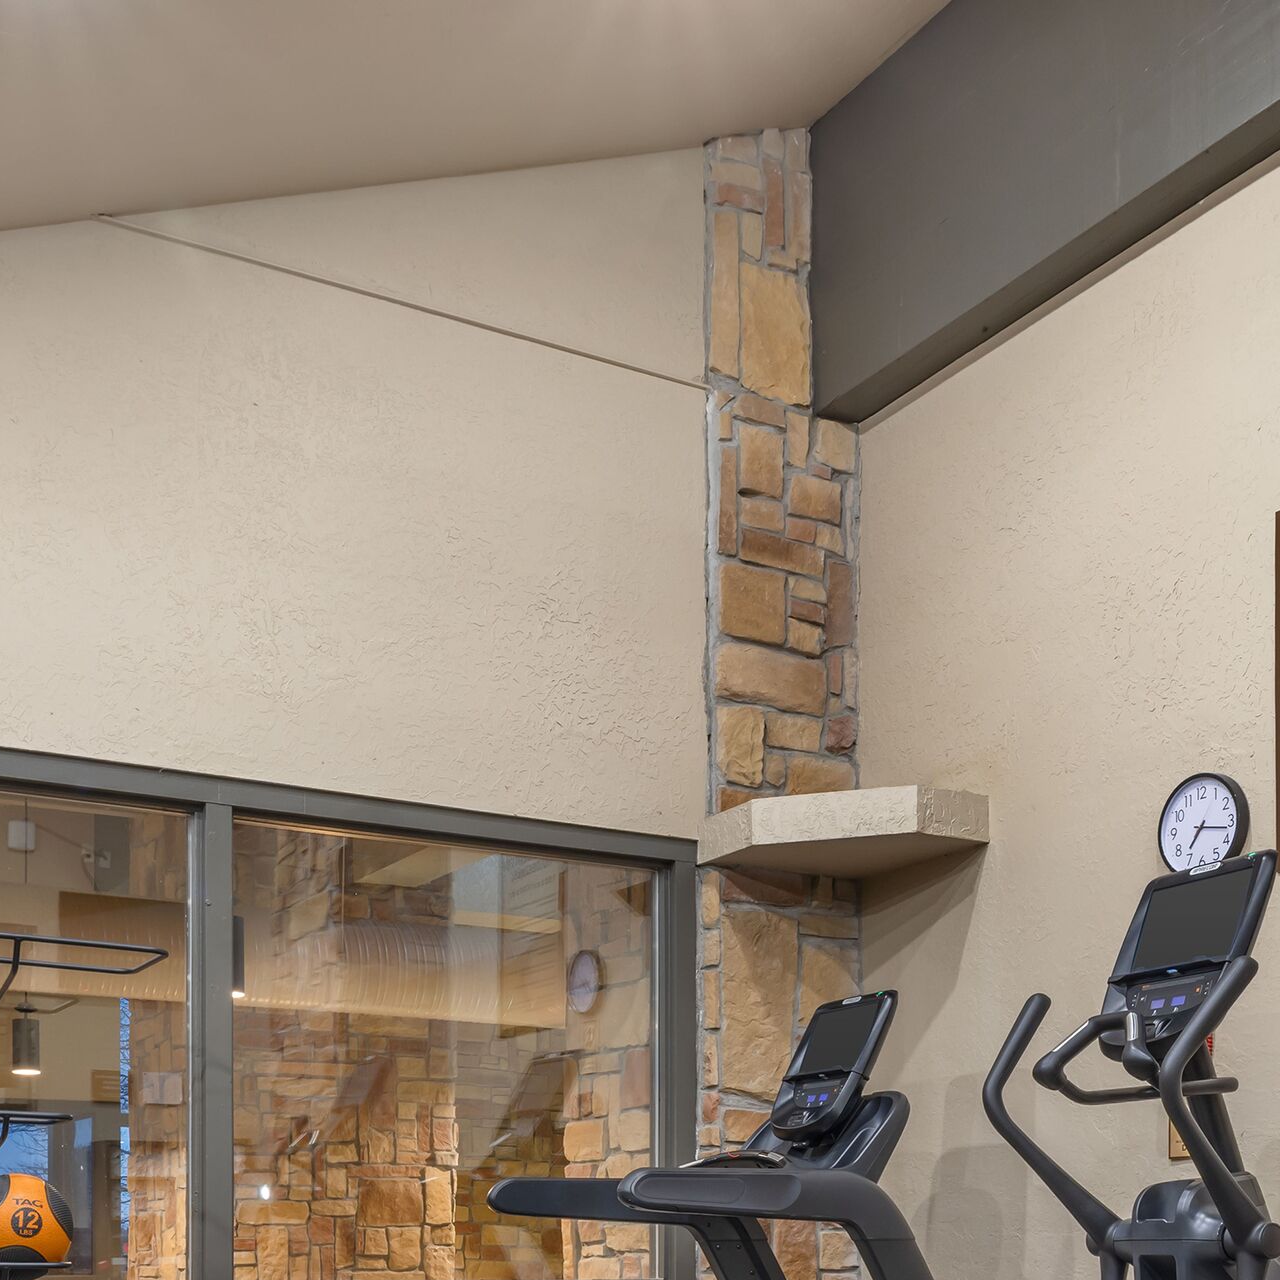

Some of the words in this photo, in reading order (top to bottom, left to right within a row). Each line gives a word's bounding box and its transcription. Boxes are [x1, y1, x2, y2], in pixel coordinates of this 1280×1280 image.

[1196, 785, 1207, 801] 12
[1184, 794, 1193, 808] 11
[1222, 796, 1230, 811] 2
[1174, 809, 1185, 823] 10
[1227, 813, 1235, 828] 3
[1170, 827, 1178, 840] 9
[1222, 833, 1230, 845] 4
[1175, 843, 1182, 857] 8
[1212, 847, 1220, 861] 5
[1186, 853, 1193, 867] 7
[1198, 855, 1206, 866] 6
[12, 1198, 43, 1208] TAG
[14, 1211, 39, 1229] 12
